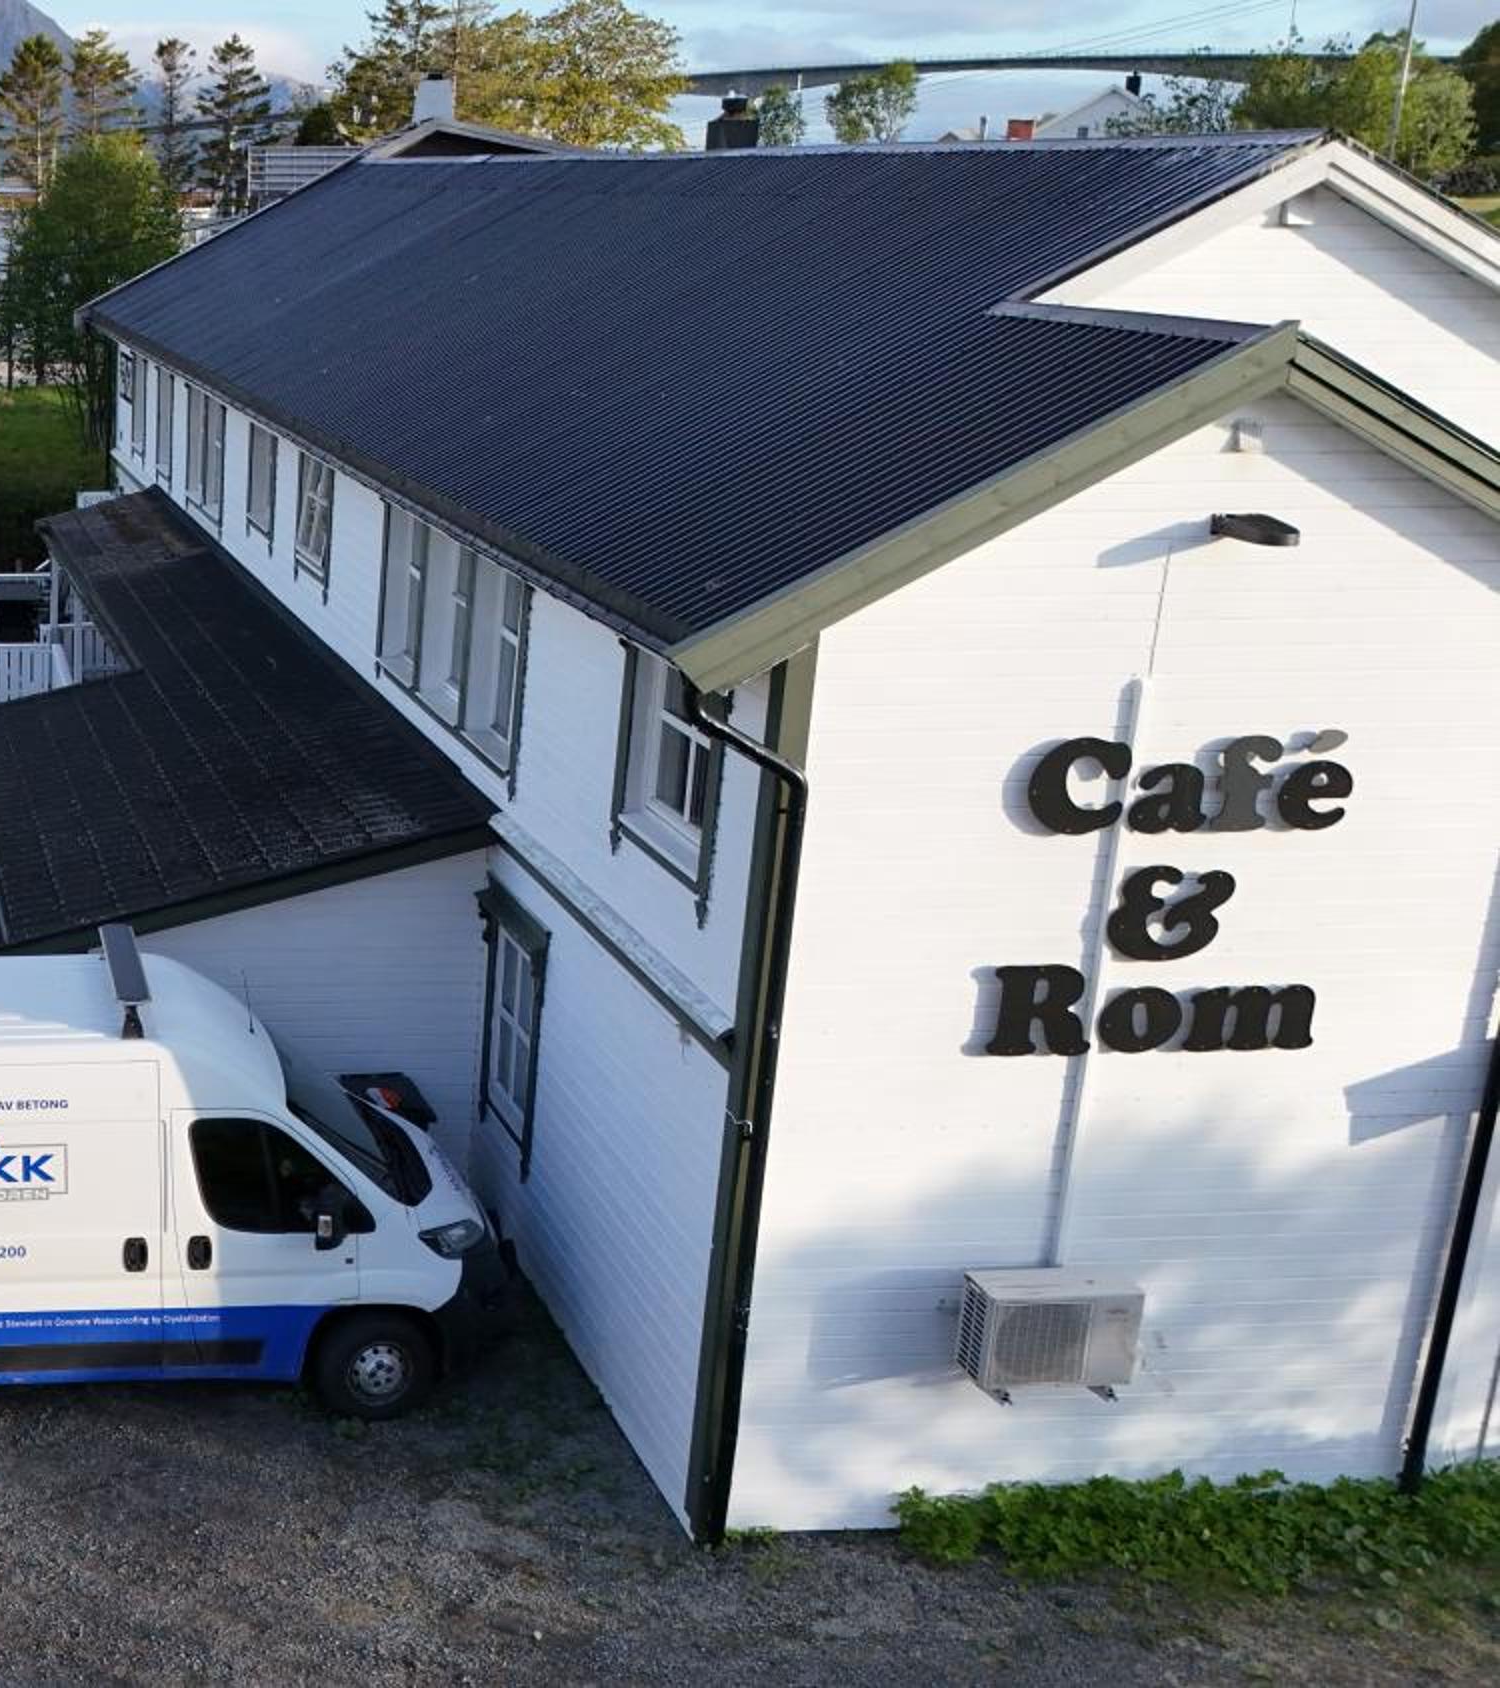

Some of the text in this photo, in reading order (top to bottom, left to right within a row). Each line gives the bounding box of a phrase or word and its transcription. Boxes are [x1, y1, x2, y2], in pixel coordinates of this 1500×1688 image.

[1027, 728, 1354, 835] Café
[1106, 865, 1237, 961] &
[986, 963, 1317, 1056] Rom
[16, 1099, 69, 1110] BETONG
